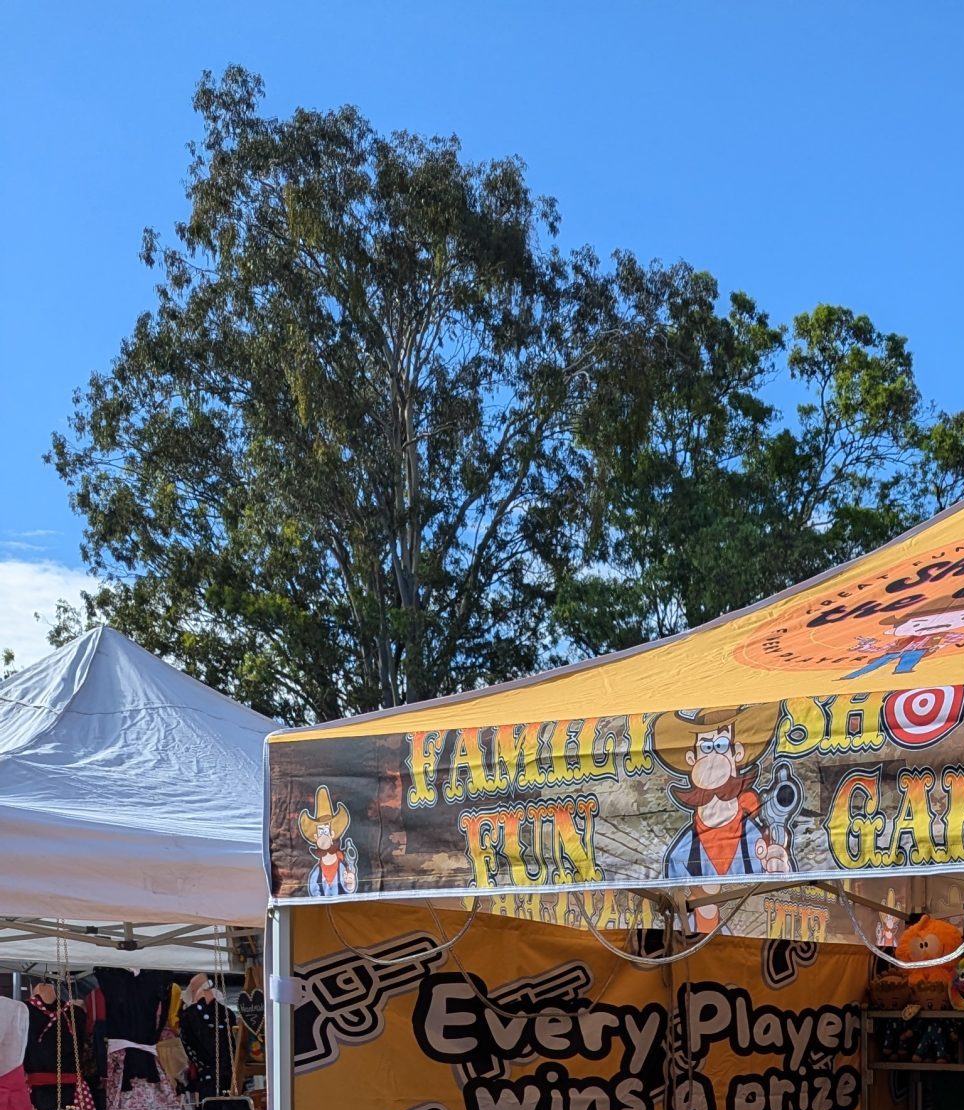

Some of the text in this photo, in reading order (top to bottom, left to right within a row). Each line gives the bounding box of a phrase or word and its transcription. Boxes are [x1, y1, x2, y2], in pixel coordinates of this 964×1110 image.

[806, 593, 928, 628] the
[458, 793, 605, 889] FUN
[422, 980, 862, 1074] Every Player
